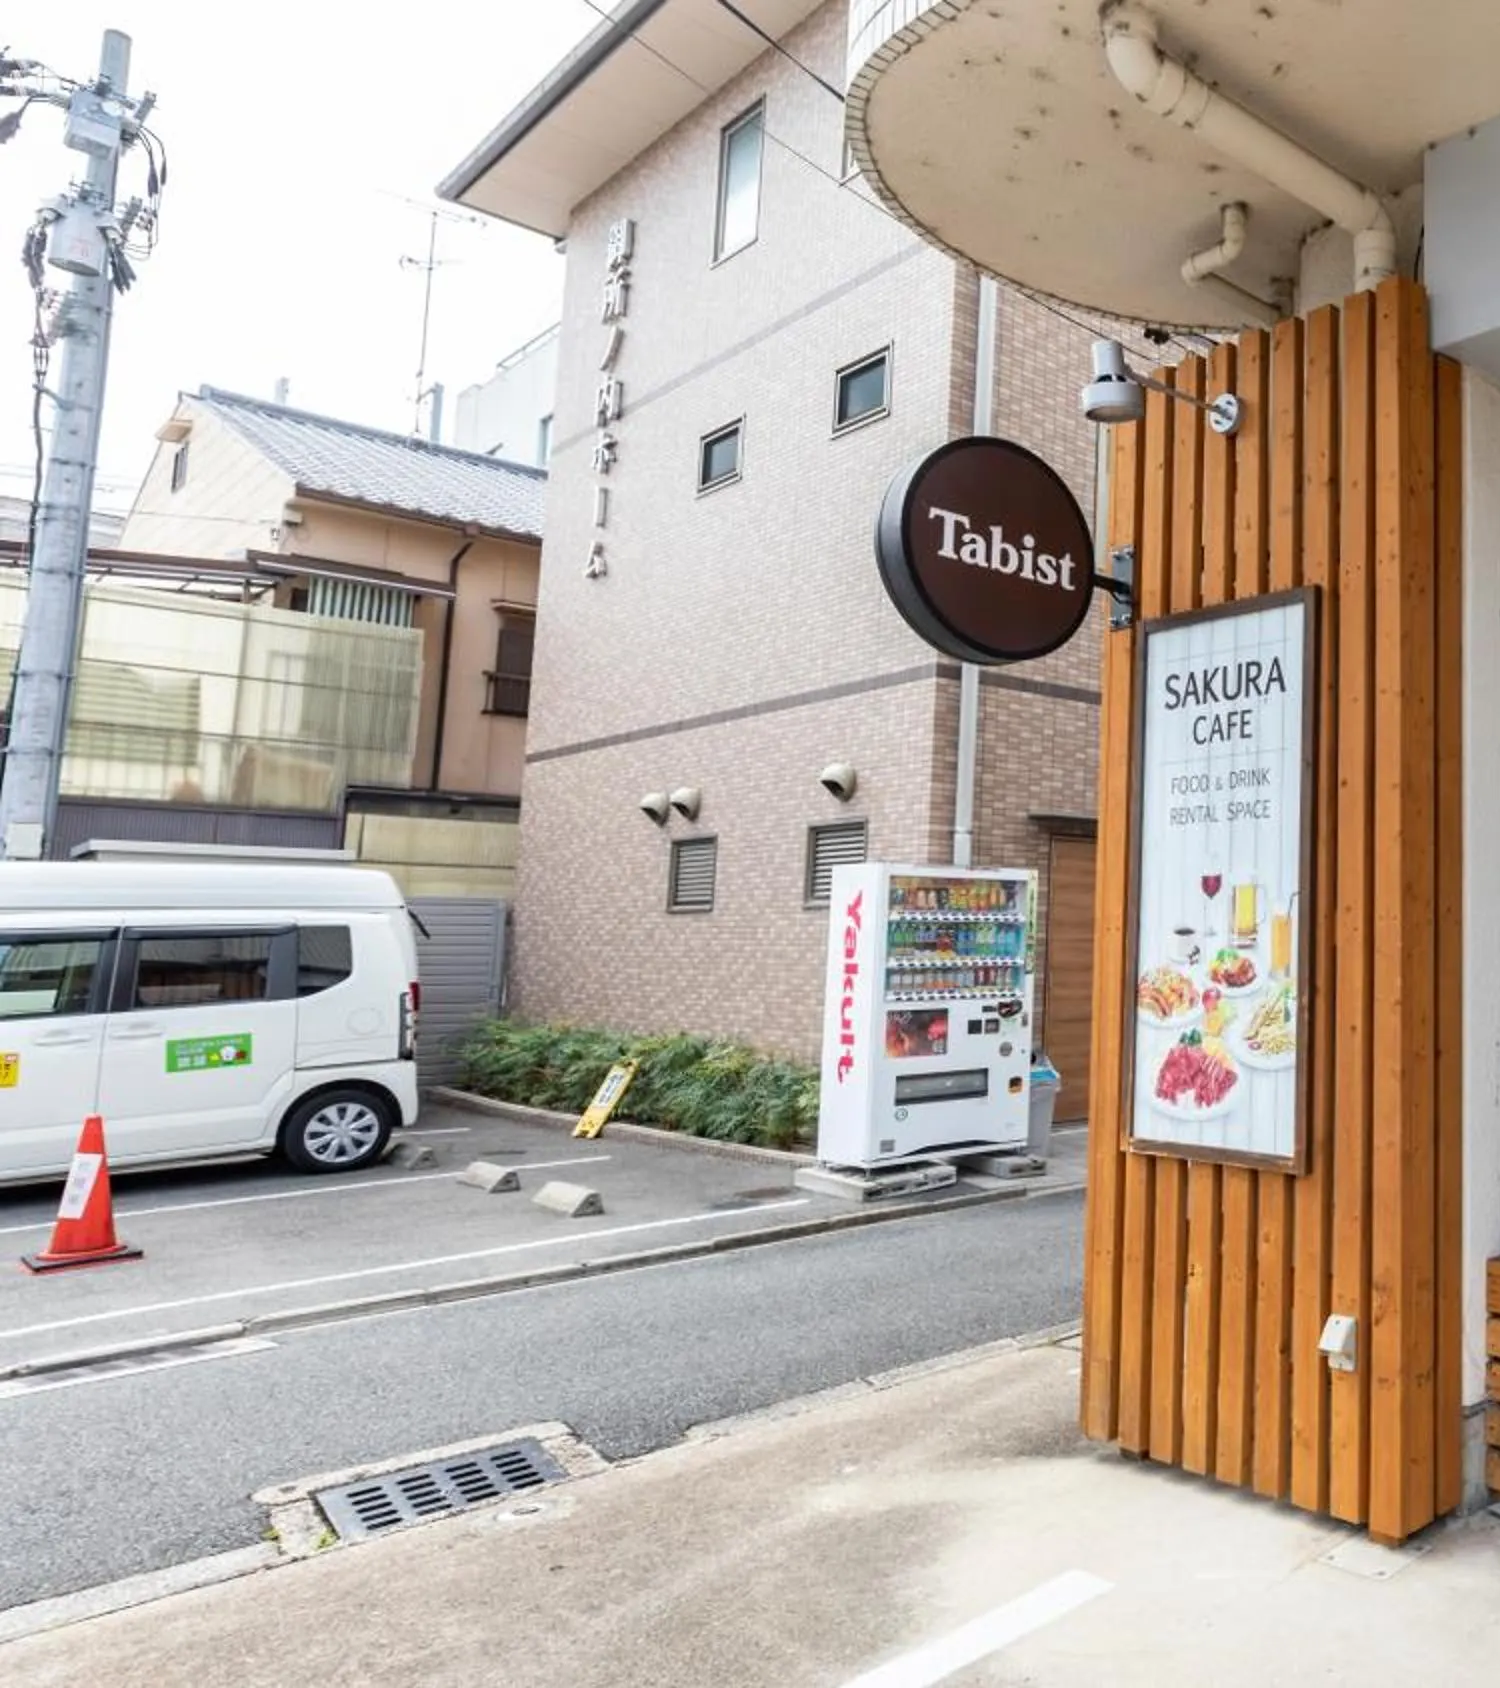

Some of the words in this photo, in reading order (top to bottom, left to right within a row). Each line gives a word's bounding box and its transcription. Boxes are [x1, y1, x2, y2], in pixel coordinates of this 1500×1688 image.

[928, 507, 1076, 591] Tabist
[1164, 656, 1286, 710] SAKURA
[1193, 709, 1253, 745] CAFE
[1171, 774, 1210, 795] FOOD
[1229, 768, 1271, 789] DRINK
[1170, 805, 1220, 826] RENTAL
[1227, 800, 1271, 821] SPACE
[838, 890, 863, 1083] Yakult
